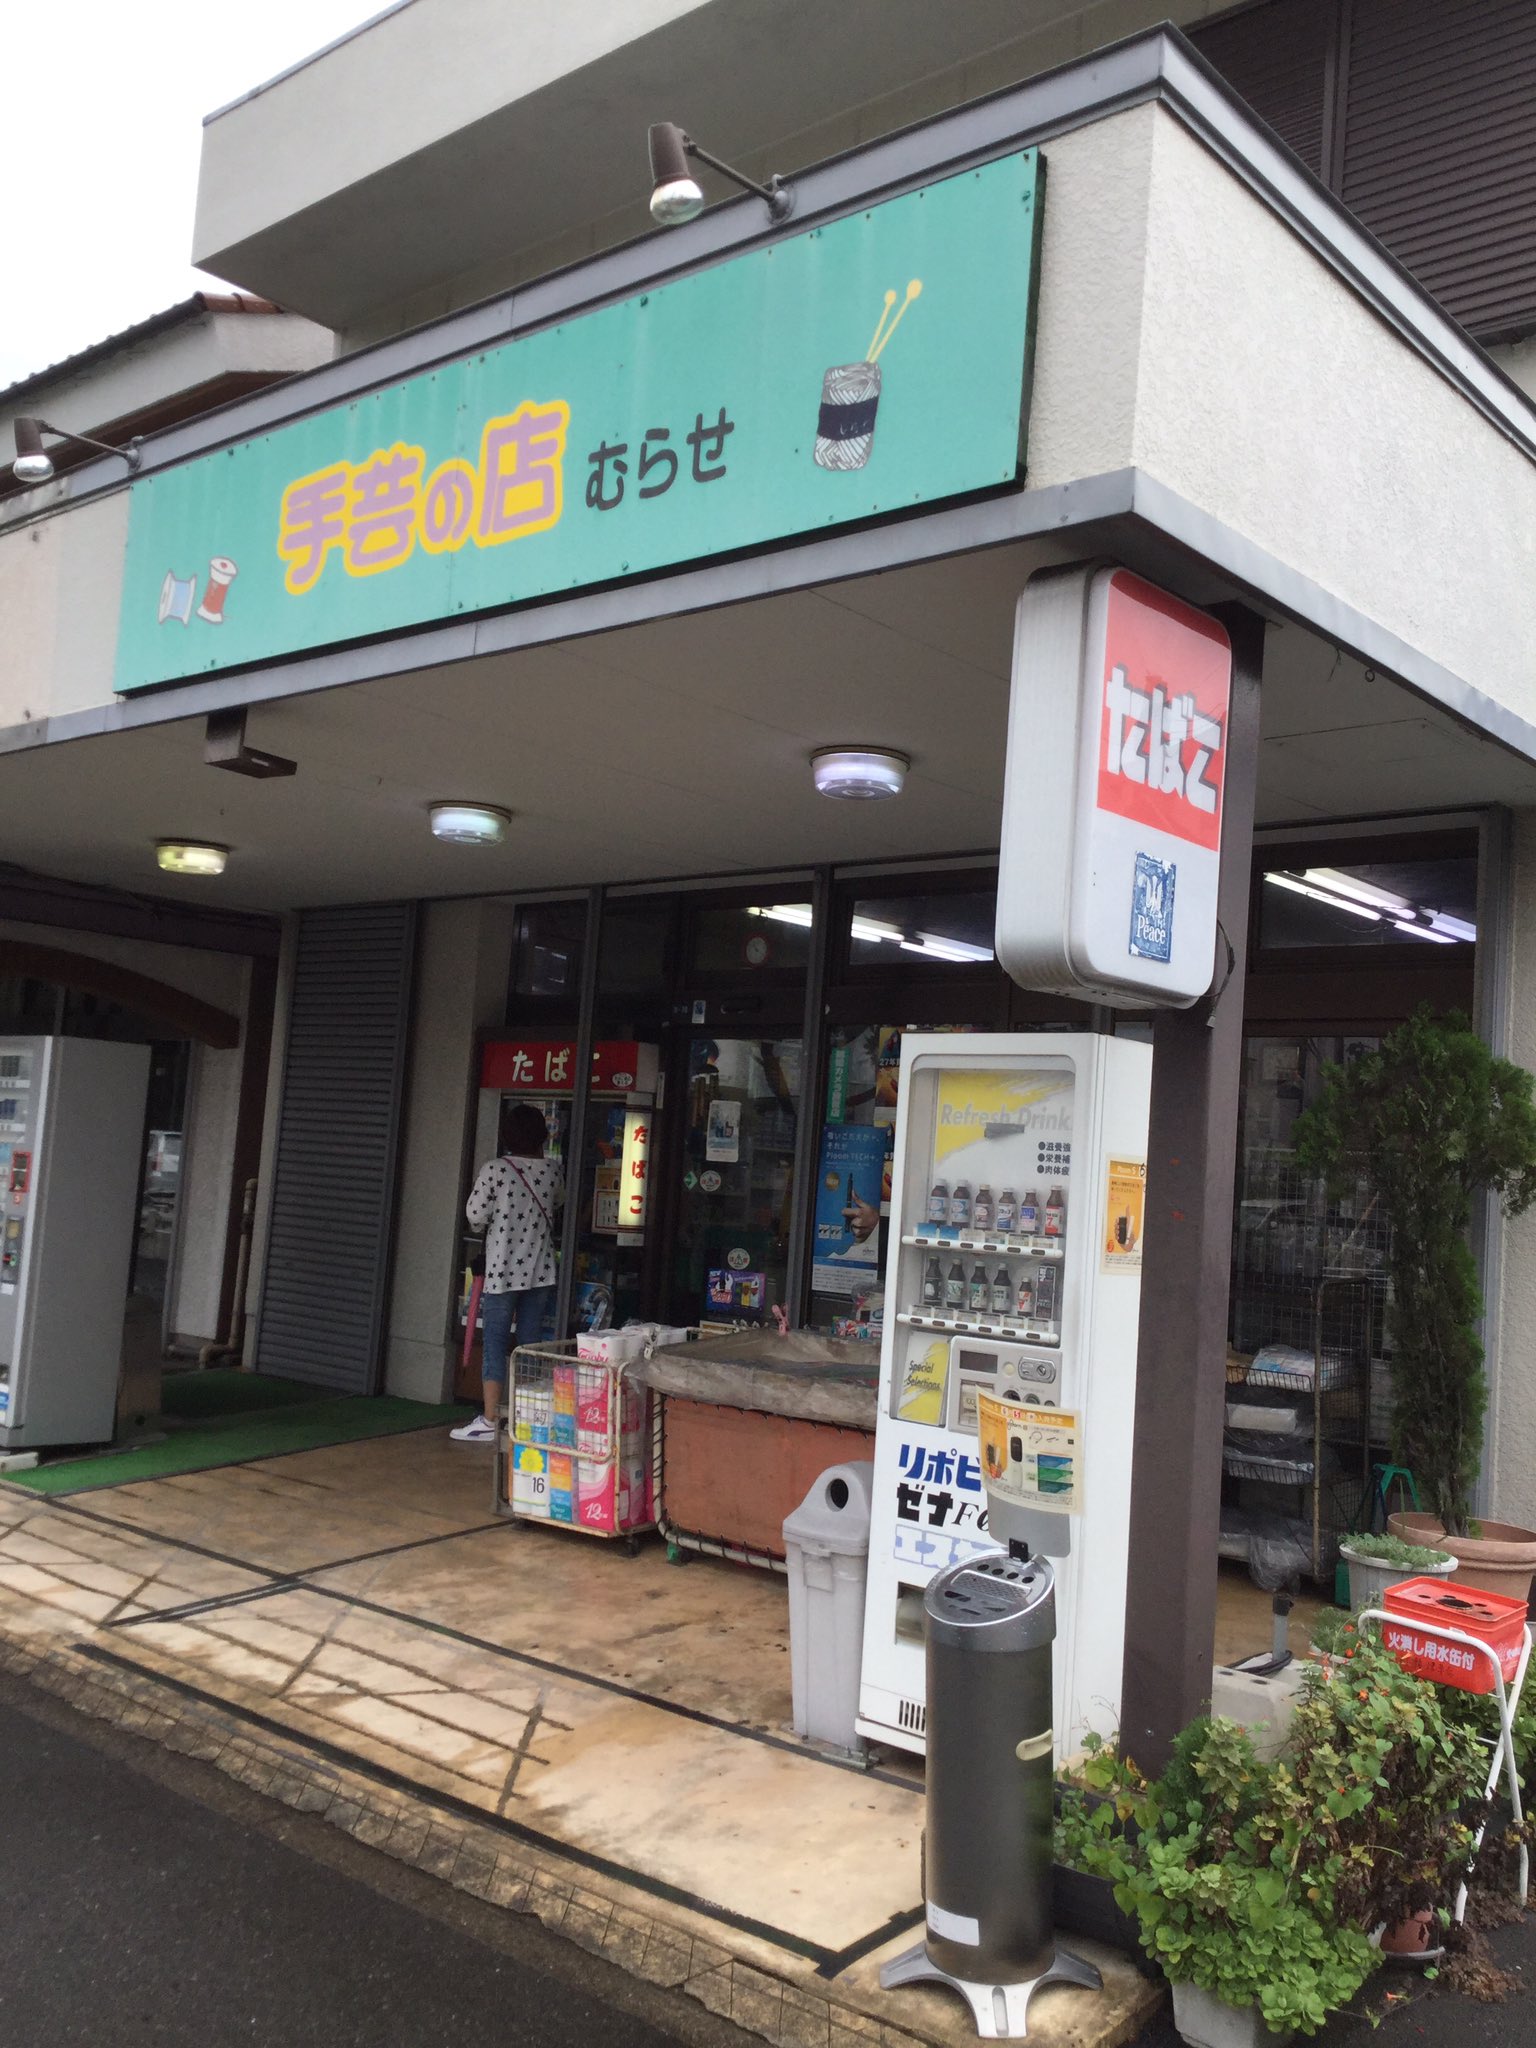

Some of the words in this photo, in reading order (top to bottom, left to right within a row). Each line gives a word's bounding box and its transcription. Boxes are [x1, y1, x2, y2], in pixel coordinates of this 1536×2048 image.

[279, 402, 568, 593] 手芸の店
[585, 407, 734, 512] むらせ
[1106, 666, 1221, 814] たばこ
[1136, 914, 1166, 944] Peace
[941, 1103, 1010, 1126] Refresh
[1020, 1105, 1072, 1131] Drink
[909, 1359, 935, 1374] Special
[906, 1375, 941, 1392] Selections
[532, 1477, 545, 1494] 16
